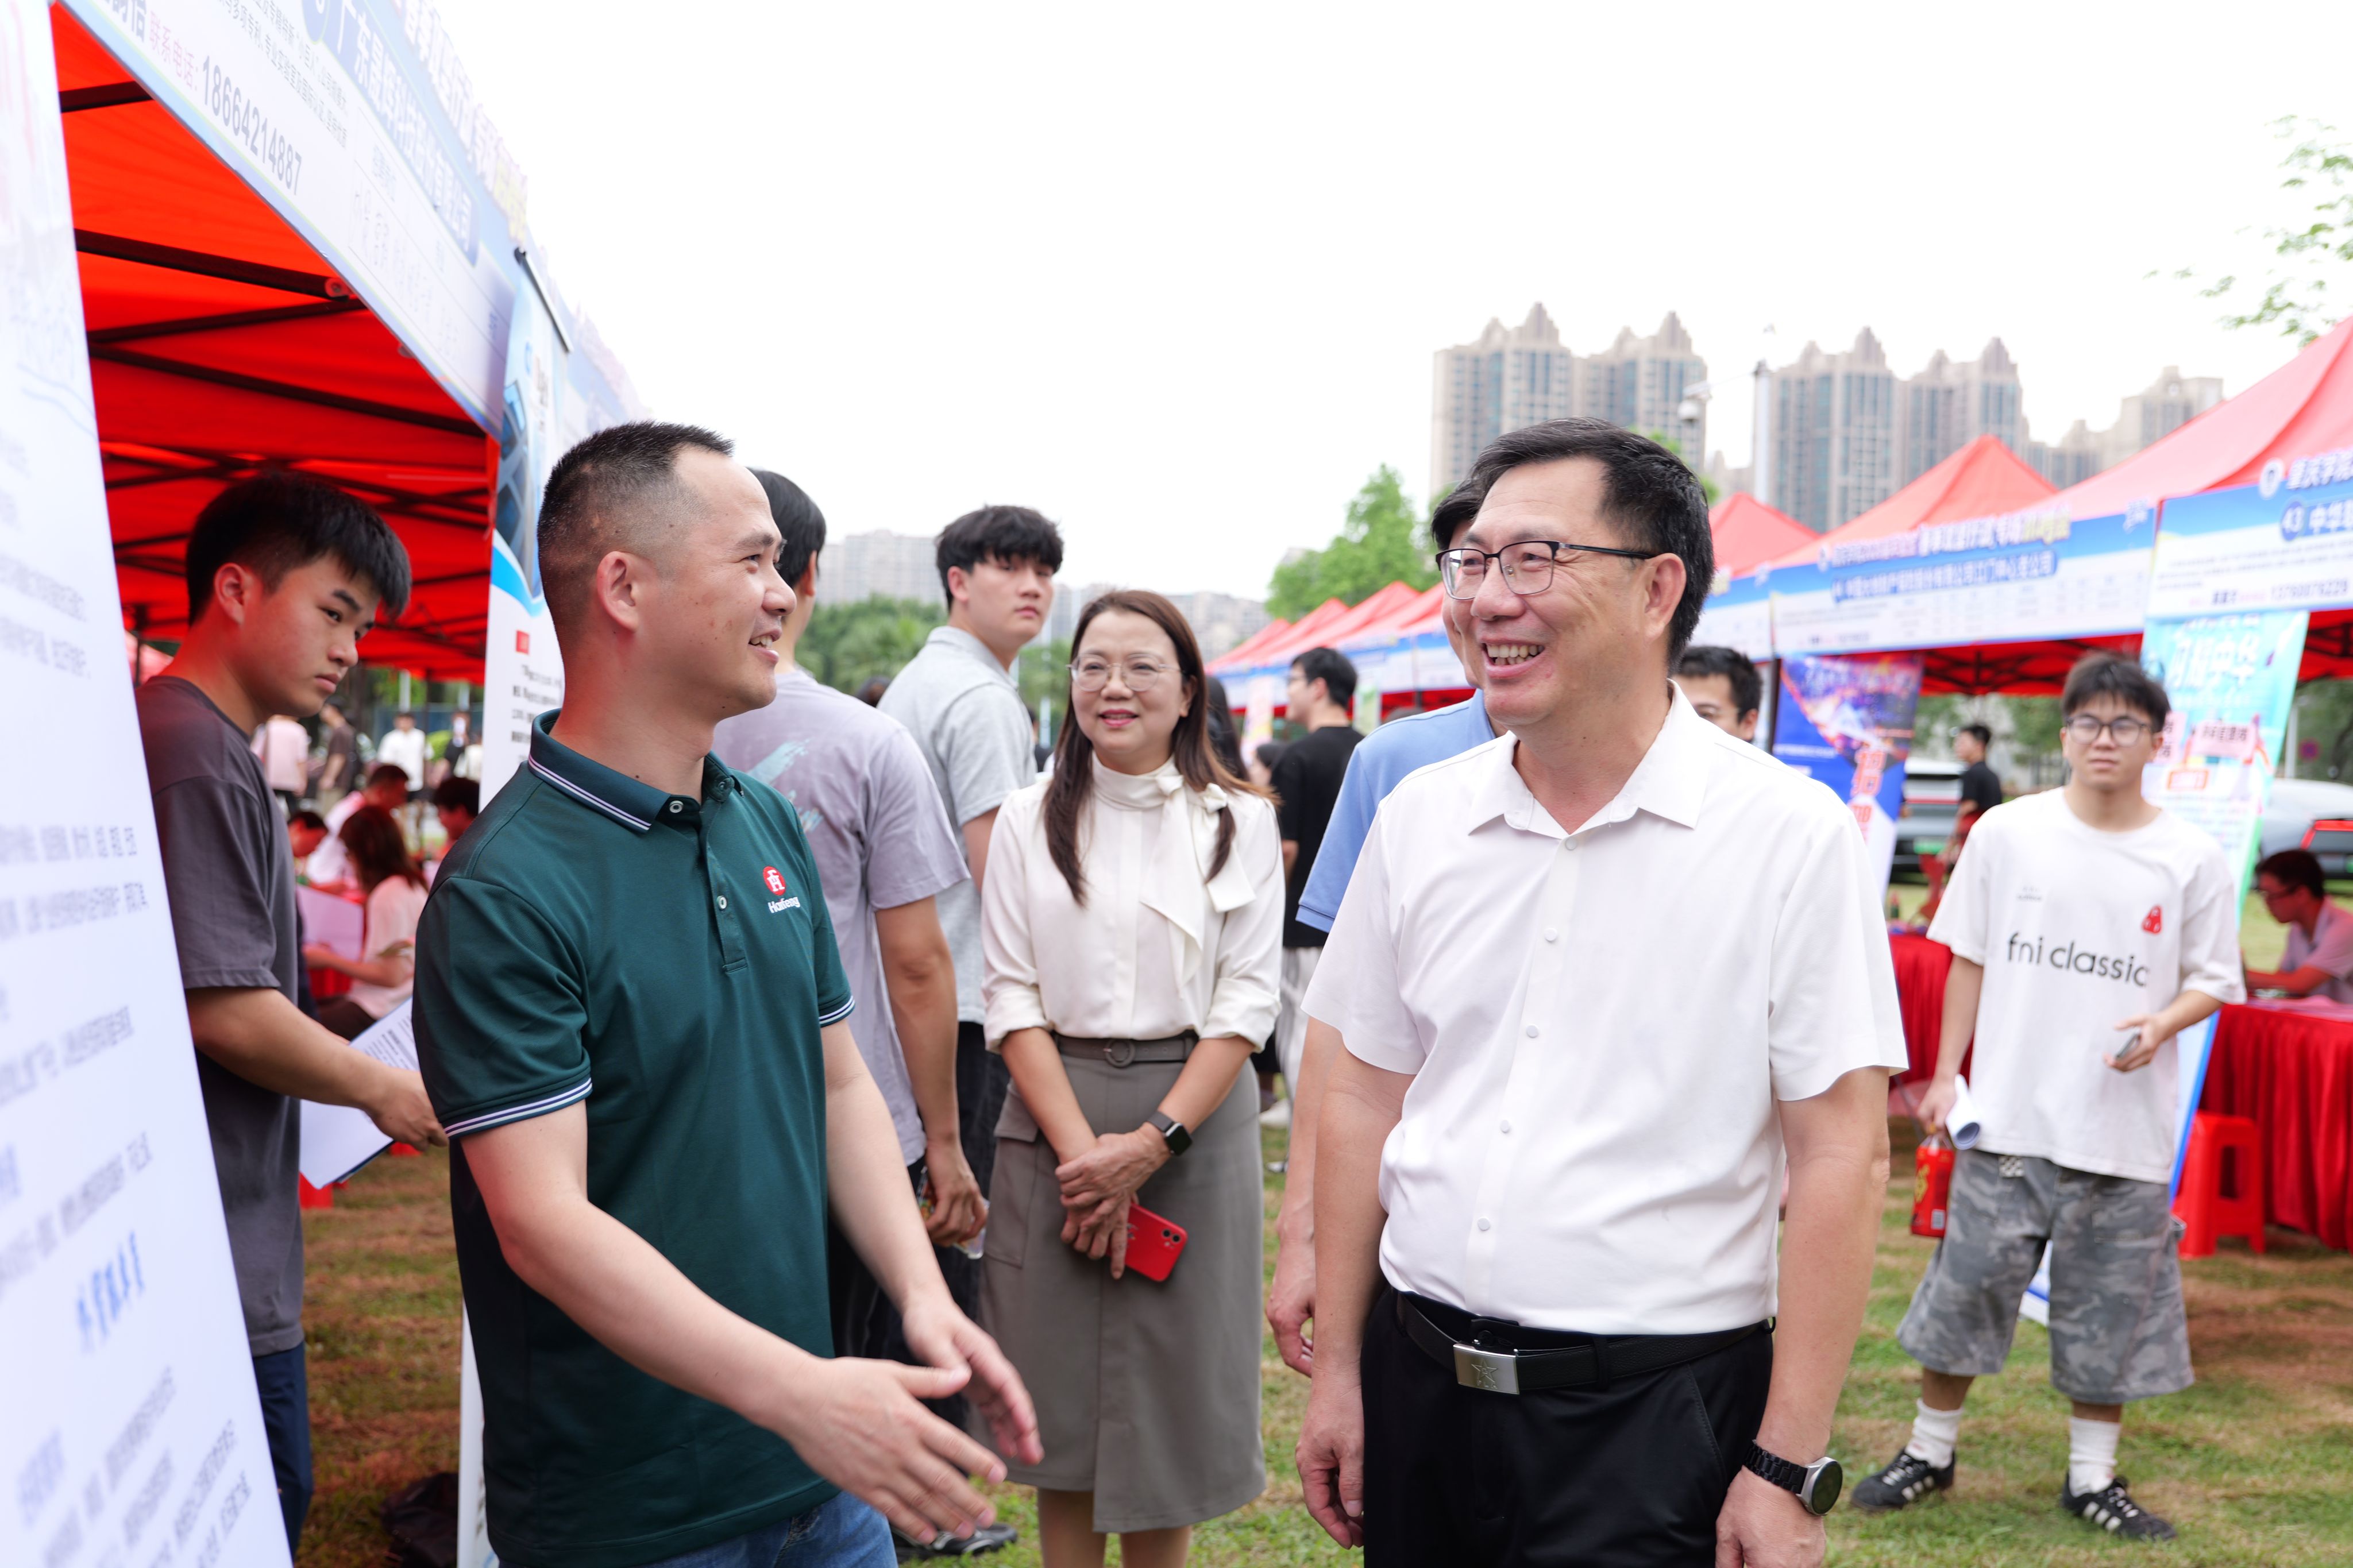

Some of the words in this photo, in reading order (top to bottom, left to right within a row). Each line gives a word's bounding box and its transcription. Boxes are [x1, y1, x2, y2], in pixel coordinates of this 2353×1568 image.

[203, 55, 302, 196] 18664214887
[2283, 505, 2305, 534] 43
[767, 896, 801, 913] Haifeng
[2007, 931, 2044, 964] fni
[2049, 940, 2150, 988] classic
